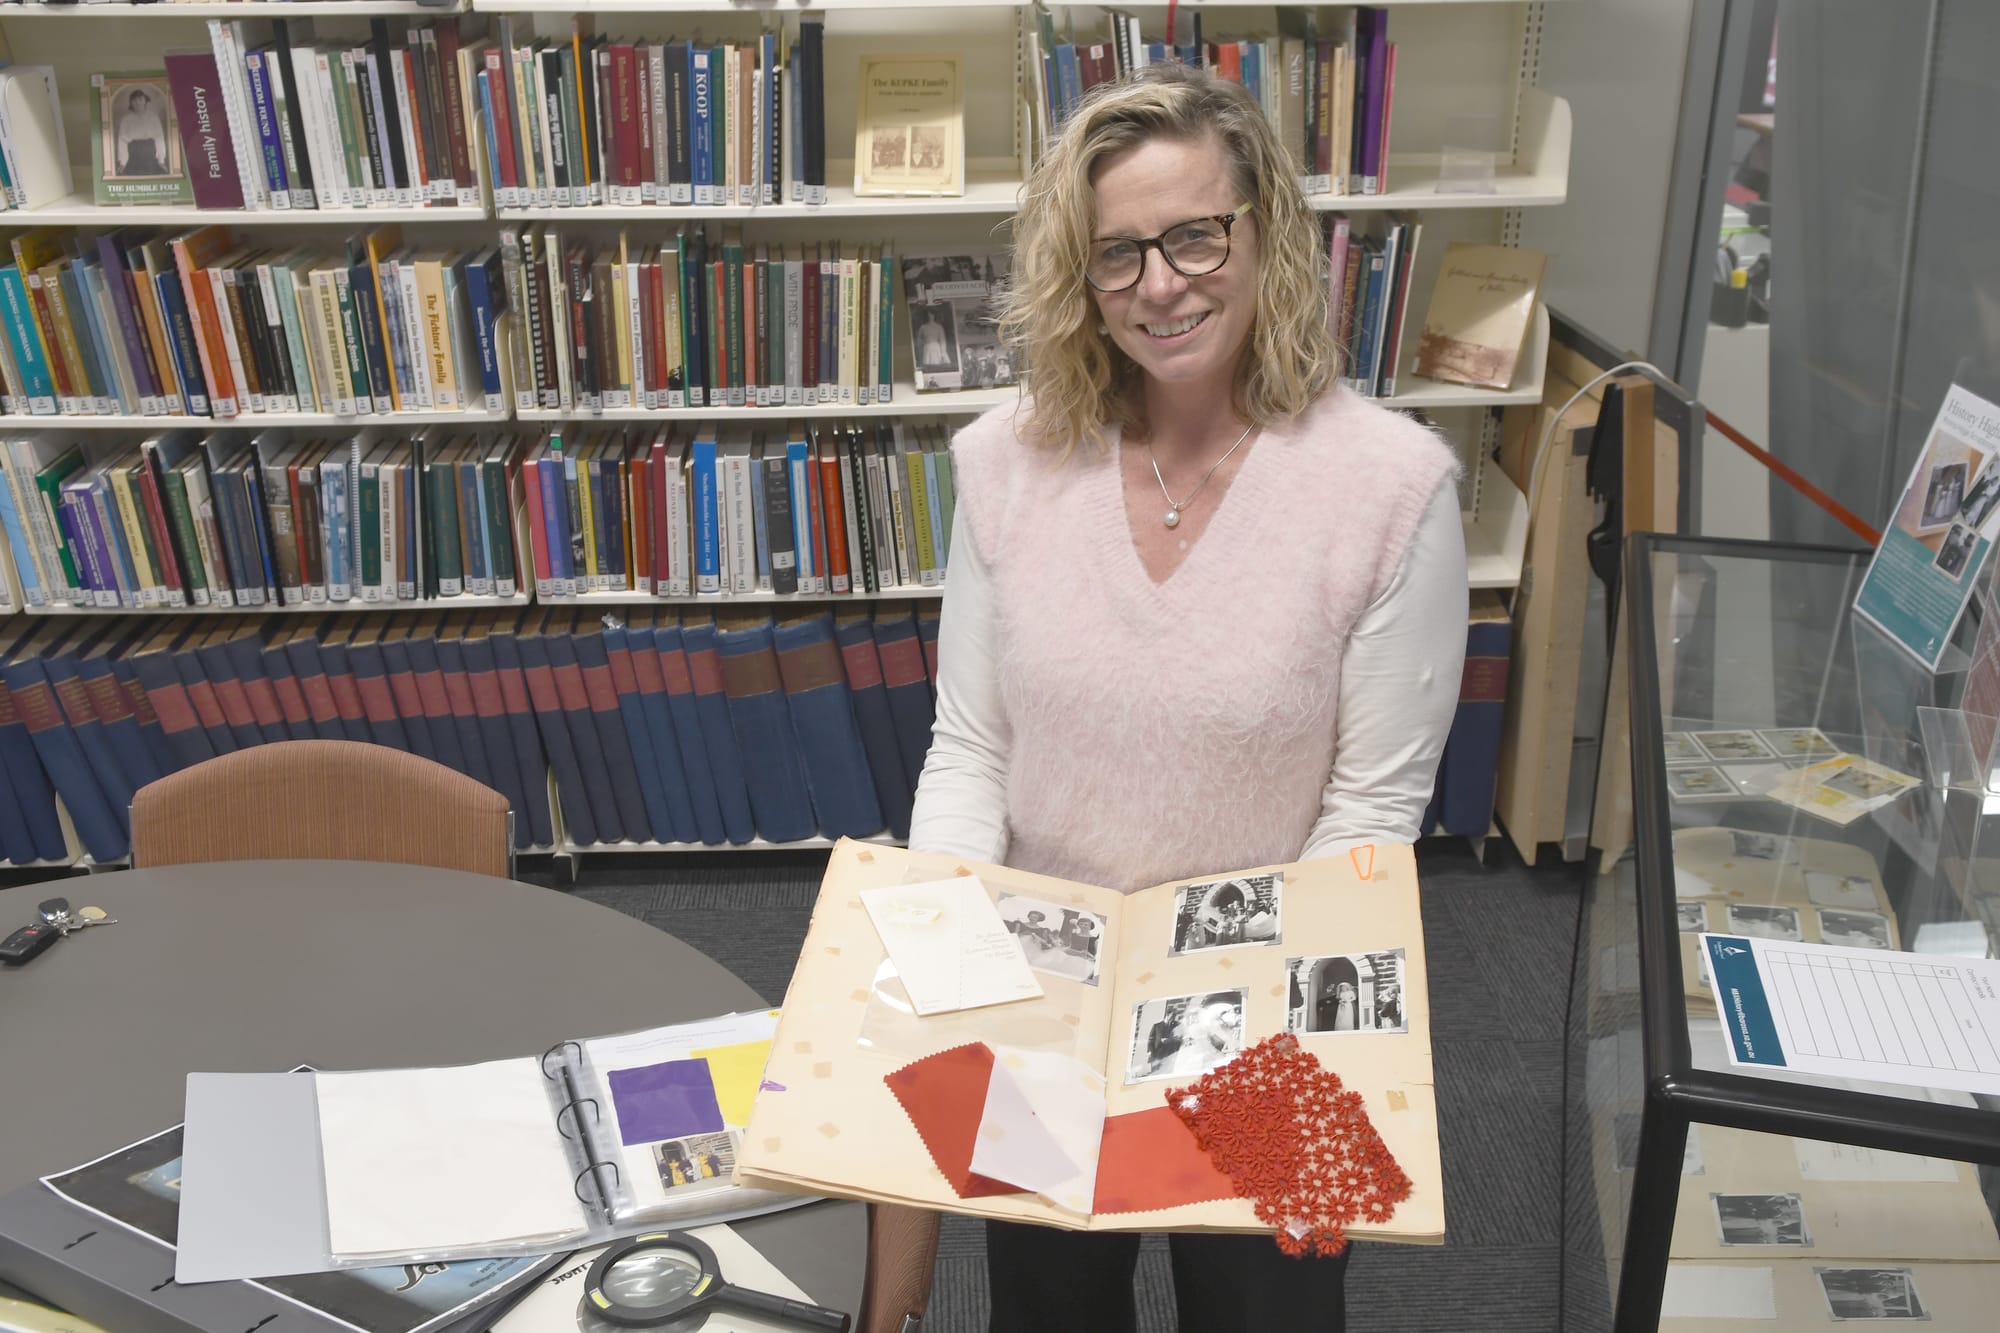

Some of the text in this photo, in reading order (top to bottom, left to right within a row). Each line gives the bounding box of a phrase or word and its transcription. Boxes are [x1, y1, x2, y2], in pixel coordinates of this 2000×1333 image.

[695, 73, 707, 118] KOOP
[922, 79, 948, 88] Family
[193, 86, 221, 178] Family history
[258, 106, 270, 136] FOUND
[126, 184, 157, 192] HUMBLE
[788, 271, 799, 328] WITH PRIDE
[426, 294, 437, 310] The
[433, 352, 447, 384] Family
[633, 332, 641, 355] Family
[1946, 399, 1978, 429] History
